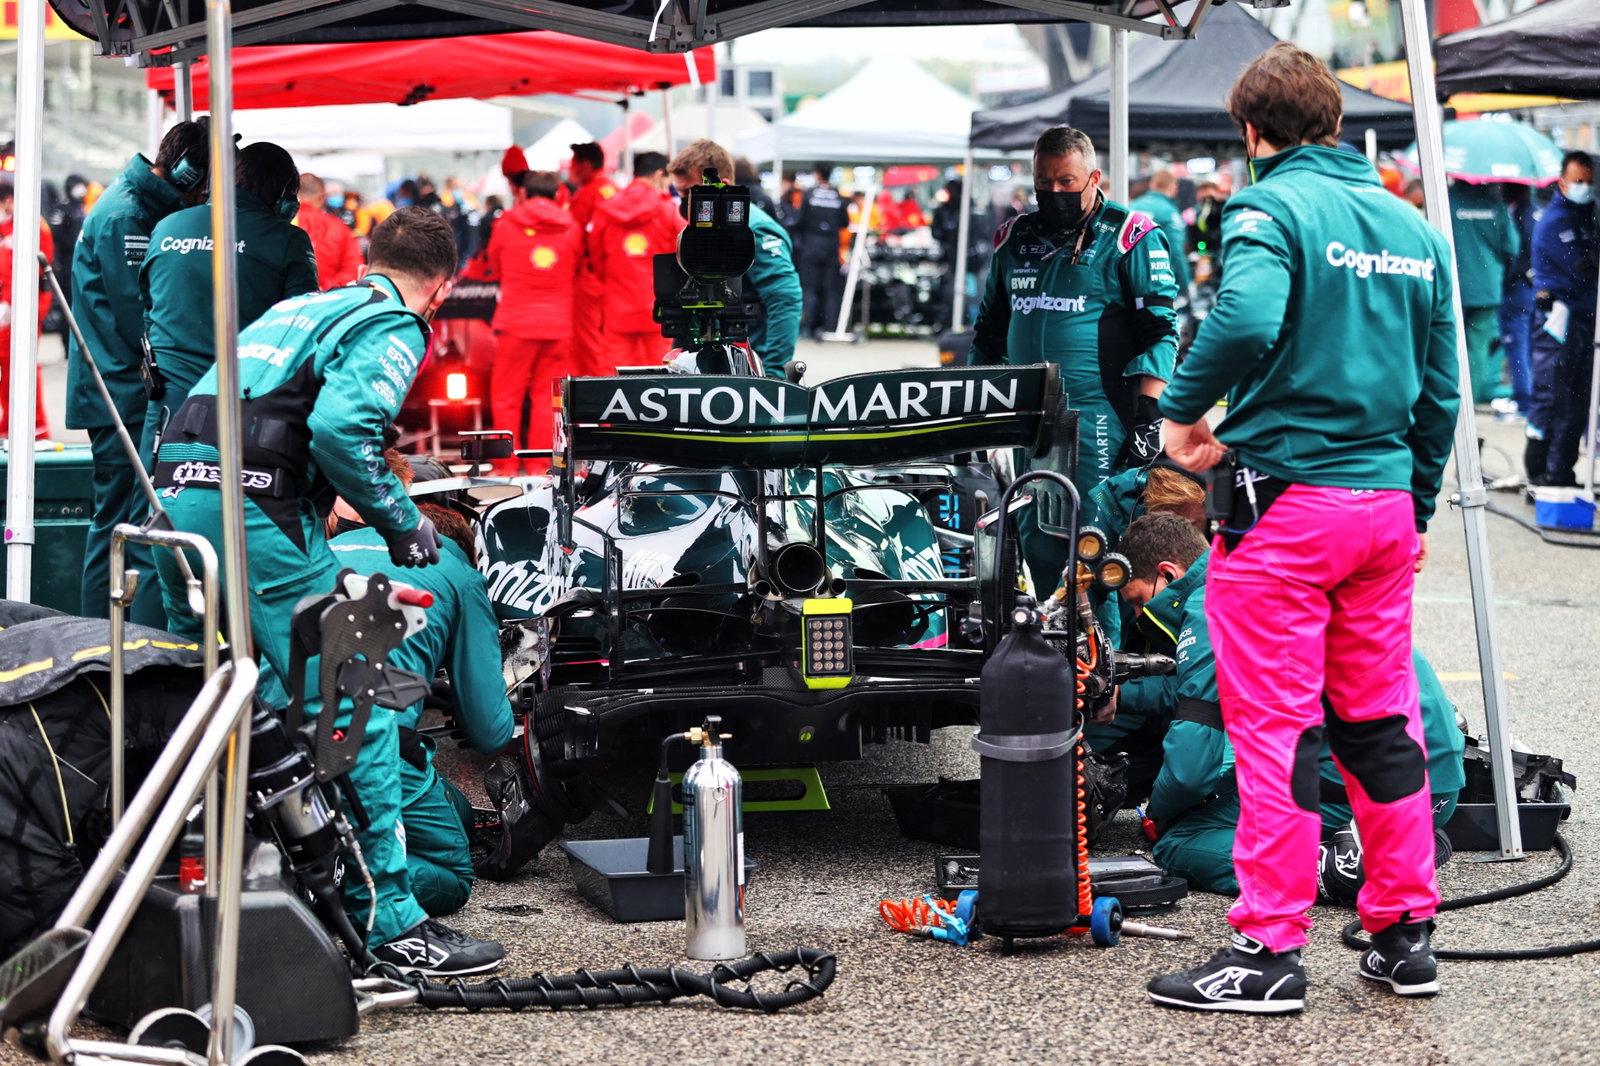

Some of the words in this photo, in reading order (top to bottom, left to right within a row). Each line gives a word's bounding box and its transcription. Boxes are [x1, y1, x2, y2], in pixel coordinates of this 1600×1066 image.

[1326, 240, 1435, 282] Cognizant
[1011, 277, 1037, 290] BWT
[1011, 292, 1088, 315] Cognizant
[386, 345, 412, 378] EPOS
[600, 386, 787, 426] ASTON
[810, 378, 1019, 424] MARTIN
[1094, 414, 1111, 471] MARTIN
